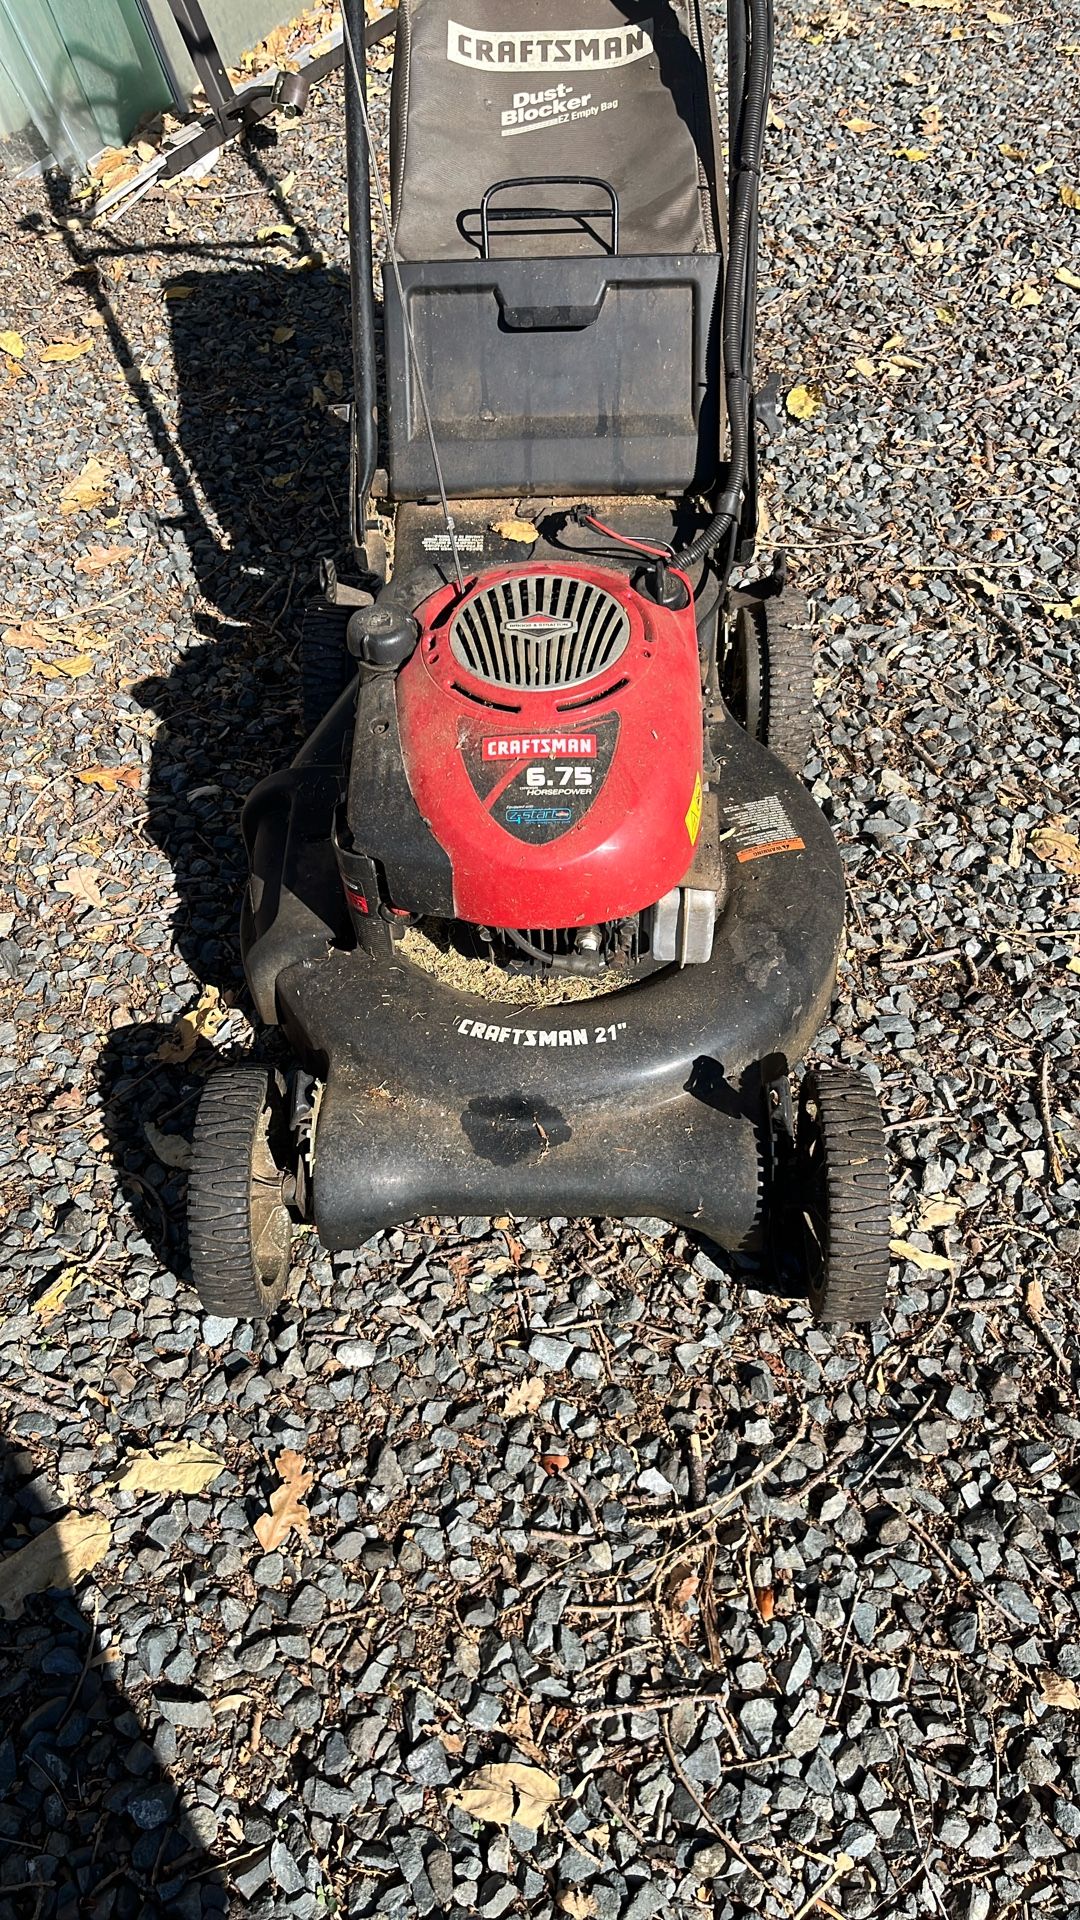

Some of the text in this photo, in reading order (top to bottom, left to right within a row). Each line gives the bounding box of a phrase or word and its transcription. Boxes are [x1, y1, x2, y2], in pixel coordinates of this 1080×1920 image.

[457, 31, 644, 63] CRAFTSMAN
[513, 83, 573, 108] Dust-
[501, 93, 592, 126] Blocker
[558, 99, 619, 124] EZ Empty Bag
[487, 738, 592, 756] CRAFTSMAN
[526, 766, 593, 787] 6.75
[526, 788, 593, 797] HORSEPOWER
[752, 845, 783, 856] WARNING
[457, 1018, 628, 1047] CRAFTSMAN 21"
